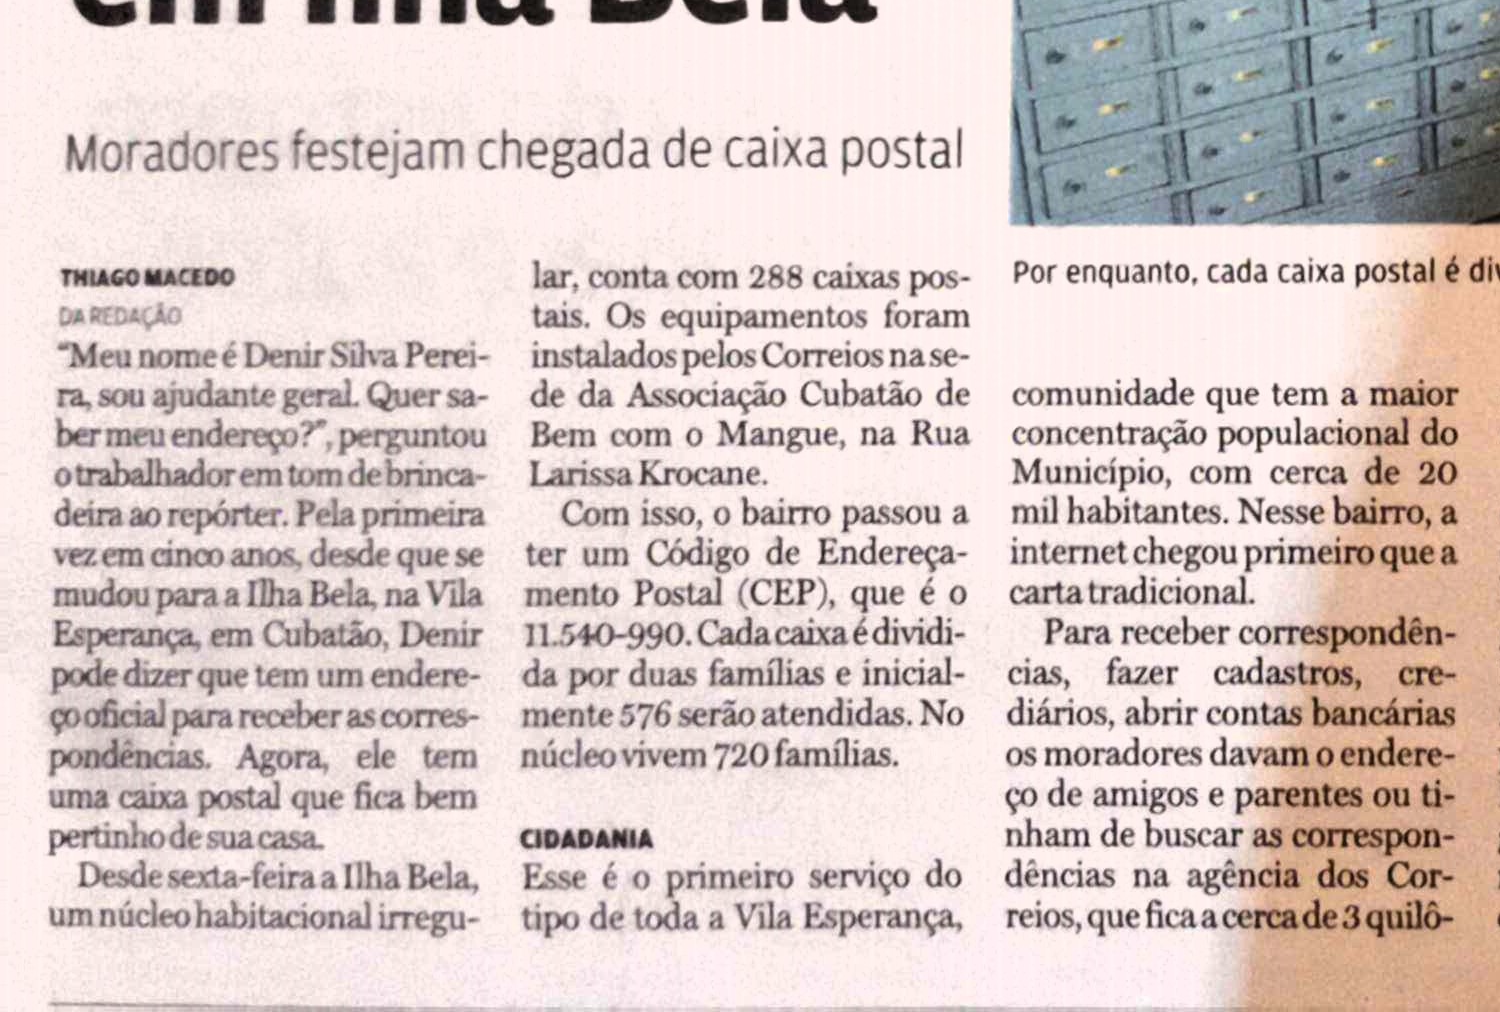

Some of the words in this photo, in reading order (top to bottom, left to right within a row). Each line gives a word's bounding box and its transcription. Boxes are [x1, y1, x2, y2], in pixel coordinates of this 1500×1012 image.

[65, 130, 280, 173] Moradores
[290, 127, 465, 180] festejam
[477, 127, 651, 180] chegada
[663, 126, 713, 169] de
[724, 125, 828, 169] caixa
[841, 126, 963, 177] postal
[60, 267, 141, 288] THIAGO
[143, 267, 236, 288] MACEDO
[532, 259, 580, 294] lar,
[587, 264, 670, 290] conta
[676, 268, 739, 290] com
[748, 263, 804, 290] 288
[812, 261, 901, 290] caixas
[908, 269, 971, 298] pos-
[1013, 259, 1058, 285] Por
[1065, 260, 1198, 289] enquanto,
[1206, 257, 1269, 284] cada
[1277, 257, 1345, 284] caixa
[1354, 256, 1436, 289] postal
[1444, 254, 1461, 284] é
[58, 305, 86, 328] DA
[88, 301, 183, 332] REDAÇÃO
[531, 300, 591, 329] tais.
[605, 300, 646, 330] Os
[660, 301, 868, 338] equipamentos
[883, 299, 971, 329] foram
[1011, 418, 1208, 454] concentração
[1217, 416, 1410, 454] populacional
[1420, 416, 1459, 447] do
[1012, 456, 1172, 493] Município,
[1189, 465, 1252, 485] com
[1269, 465, 1349, 486] cerca
[1363, 454, 1401, 486] de
[1418, 460, 1459, 486] 20
[52, 618, 202, 656] Esperança,
[209, 627, 254, 648] em
[262, 617, 390, 652] Cubatão,
[399, 619, 484, 649] Denir
[1007, 657, 1071, 691] cias,
[1106, 655, 1180, 686] fazer
[1213, 655, 1362, 691] cadastros,
[1398, 665, 1457, 687] cre-
[522, 703, 614, 729] mente
[619, 699, 672, 731] 576
[677, 699, 757, 728] serão
[760, 696, 913, 728] atendidas.
[919, 698, 965, 727] No
[1006, 695, 1115, 730] diários,
[1124, 695, 1199, 727] abrir
[1205, 701, 1303, 727] contas
[1311, 695, 1456, 727] bancárias
[47, 737, 212, 778] pondências.
[235, 742, 330, 779] Agora,
[355, 737, 397, 770] ele
[422, 744, 478, 770] tem
[48, 788, 111, 811] uma
[117, 782, 189, 811] caixa
[197, 779, 282, 819] postal
[290, 789, 345, 819] que
[353, 780, 406, 811] fica
[414, 779, 478, 811] bem
[519, 828, 654, 850] CIDADANIA
[1004, 858, 1116, 889] dências
[1133, 867, 1170, 889] na
[1186, 858, 1301, 897] agência
[1316, 858, 1370, 889] dos
[1386, 860, 1454, 890] Cor-
[521, 902, 581, 939] tipo
[588, 900, 625, 931] de
[633, 899, 700, 932] toda
[708, 910, 725, 931] a
[733, 899, 794, 931] Vila
[803, 901, 964, 938] Esperança,
